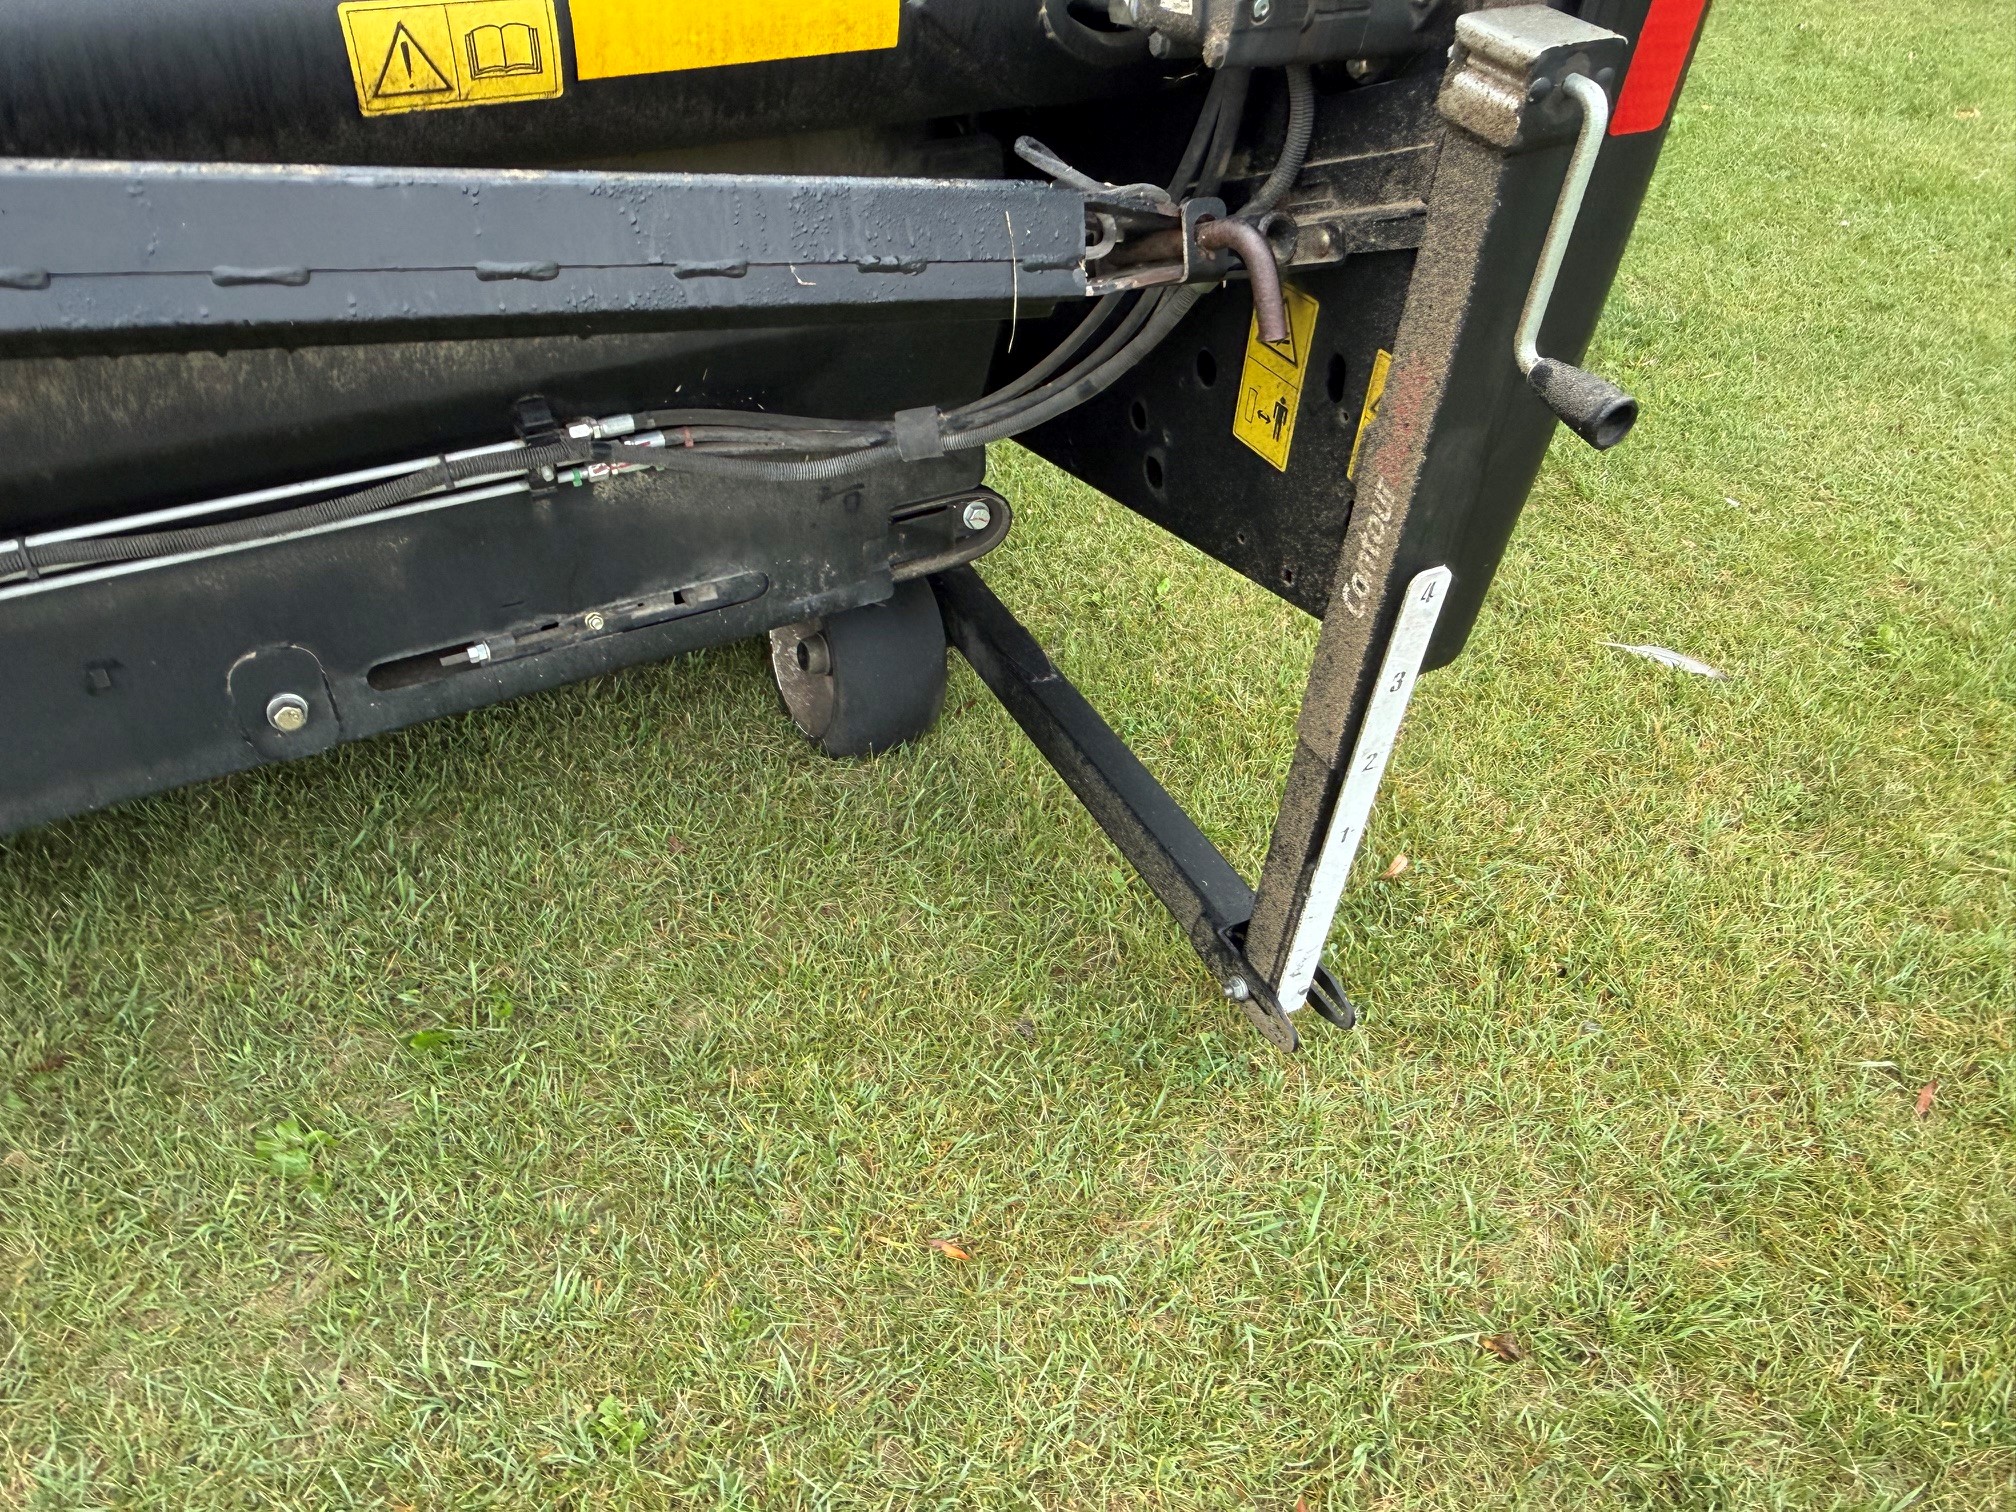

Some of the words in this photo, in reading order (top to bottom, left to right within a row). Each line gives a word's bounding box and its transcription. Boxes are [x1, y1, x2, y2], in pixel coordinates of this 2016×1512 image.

[1420, 581, 1437, 603] 4
[1389, 671, 1406, 693] 3
[1361, 752, 1378, 773] 2
[1340, 826, 1350, 843] 1
